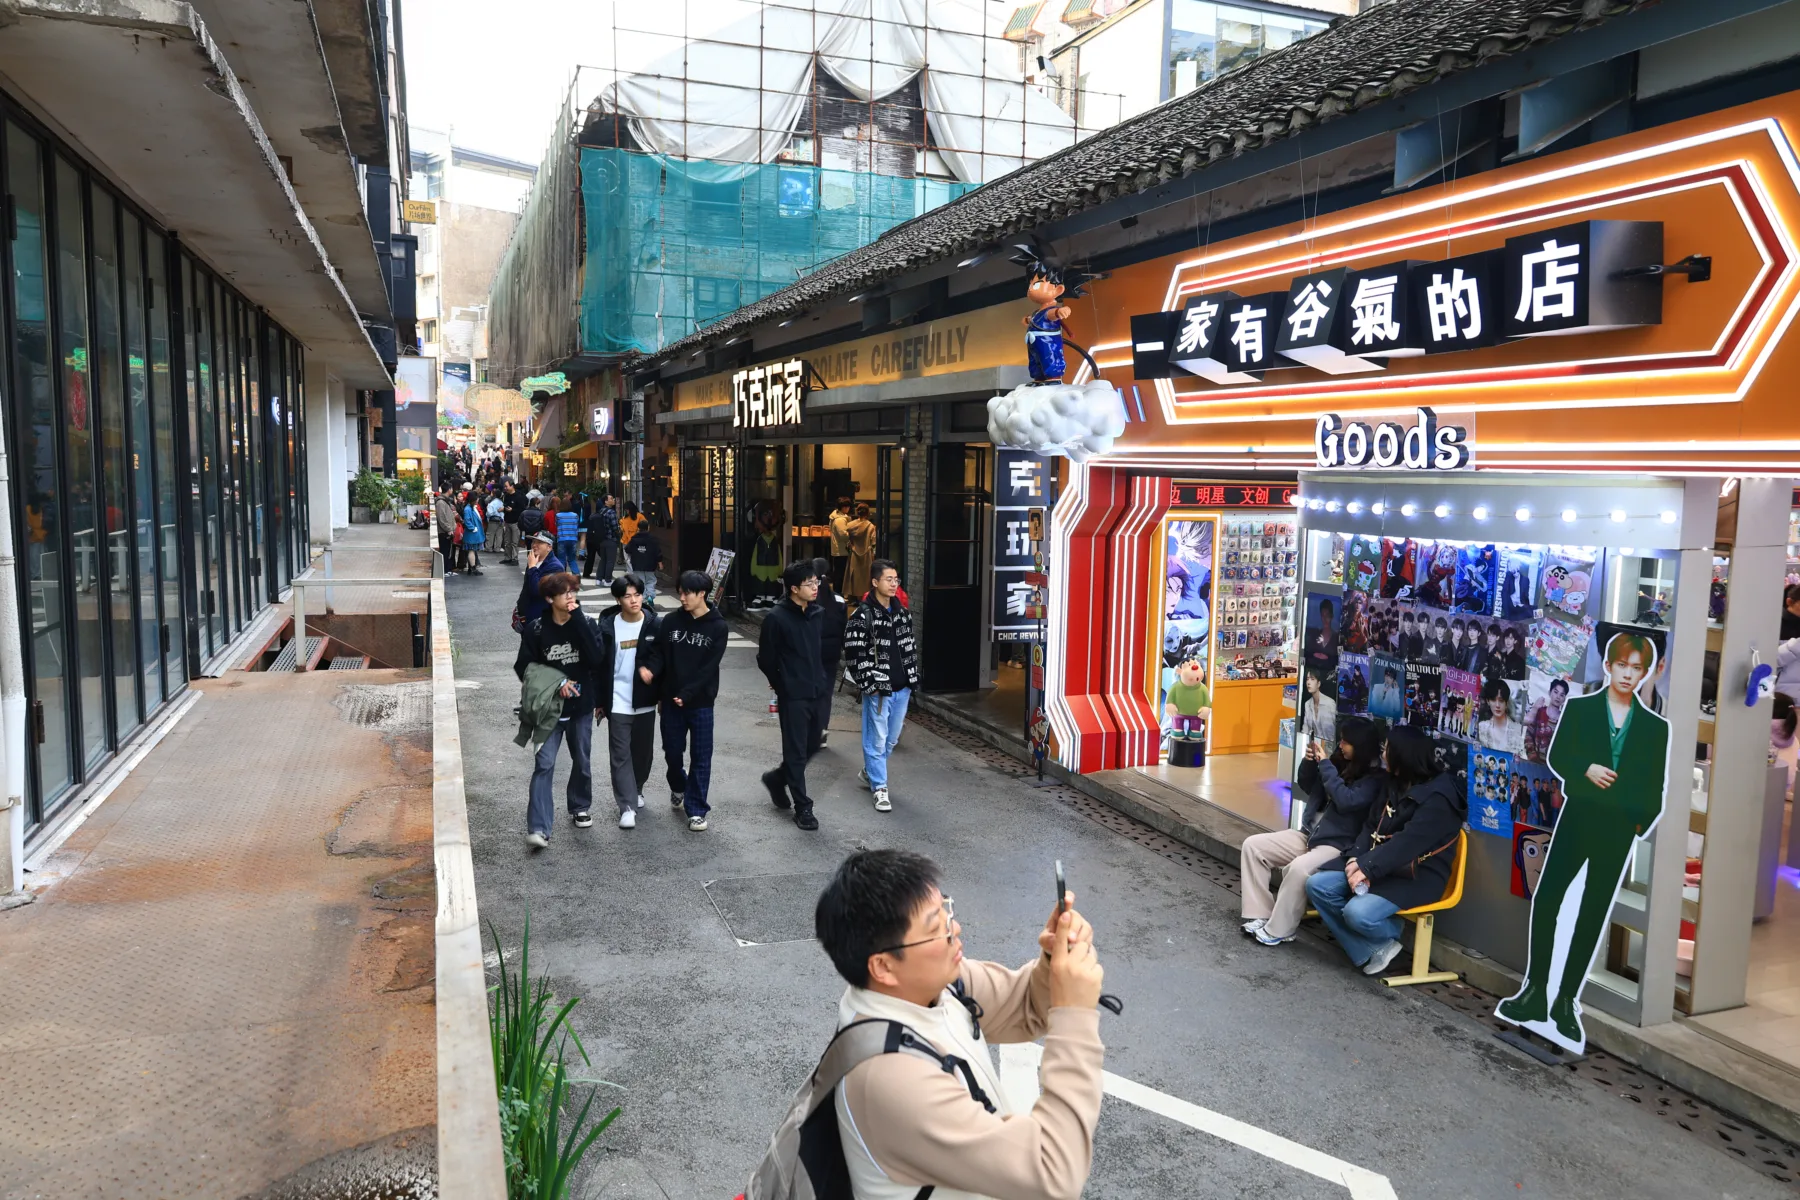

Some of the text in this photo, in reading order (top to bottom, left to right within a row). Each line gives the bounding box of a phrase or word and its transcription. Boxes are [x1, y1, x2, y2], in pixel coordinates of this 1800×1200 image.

[1136, 238, 1581, 365] 一家有谷氣的店
[695, 325, 970, 405] MAKE EAC COLATE CAREFULLY
[732, 356, 803, 428] 巧克玩家
[1314, 406, 1470, 469] Goods
[1196, 486, 1226, 505] 明星
[1240, 486, 1270, 505] 文创
[998, 632, 1018, 641] CHOC
